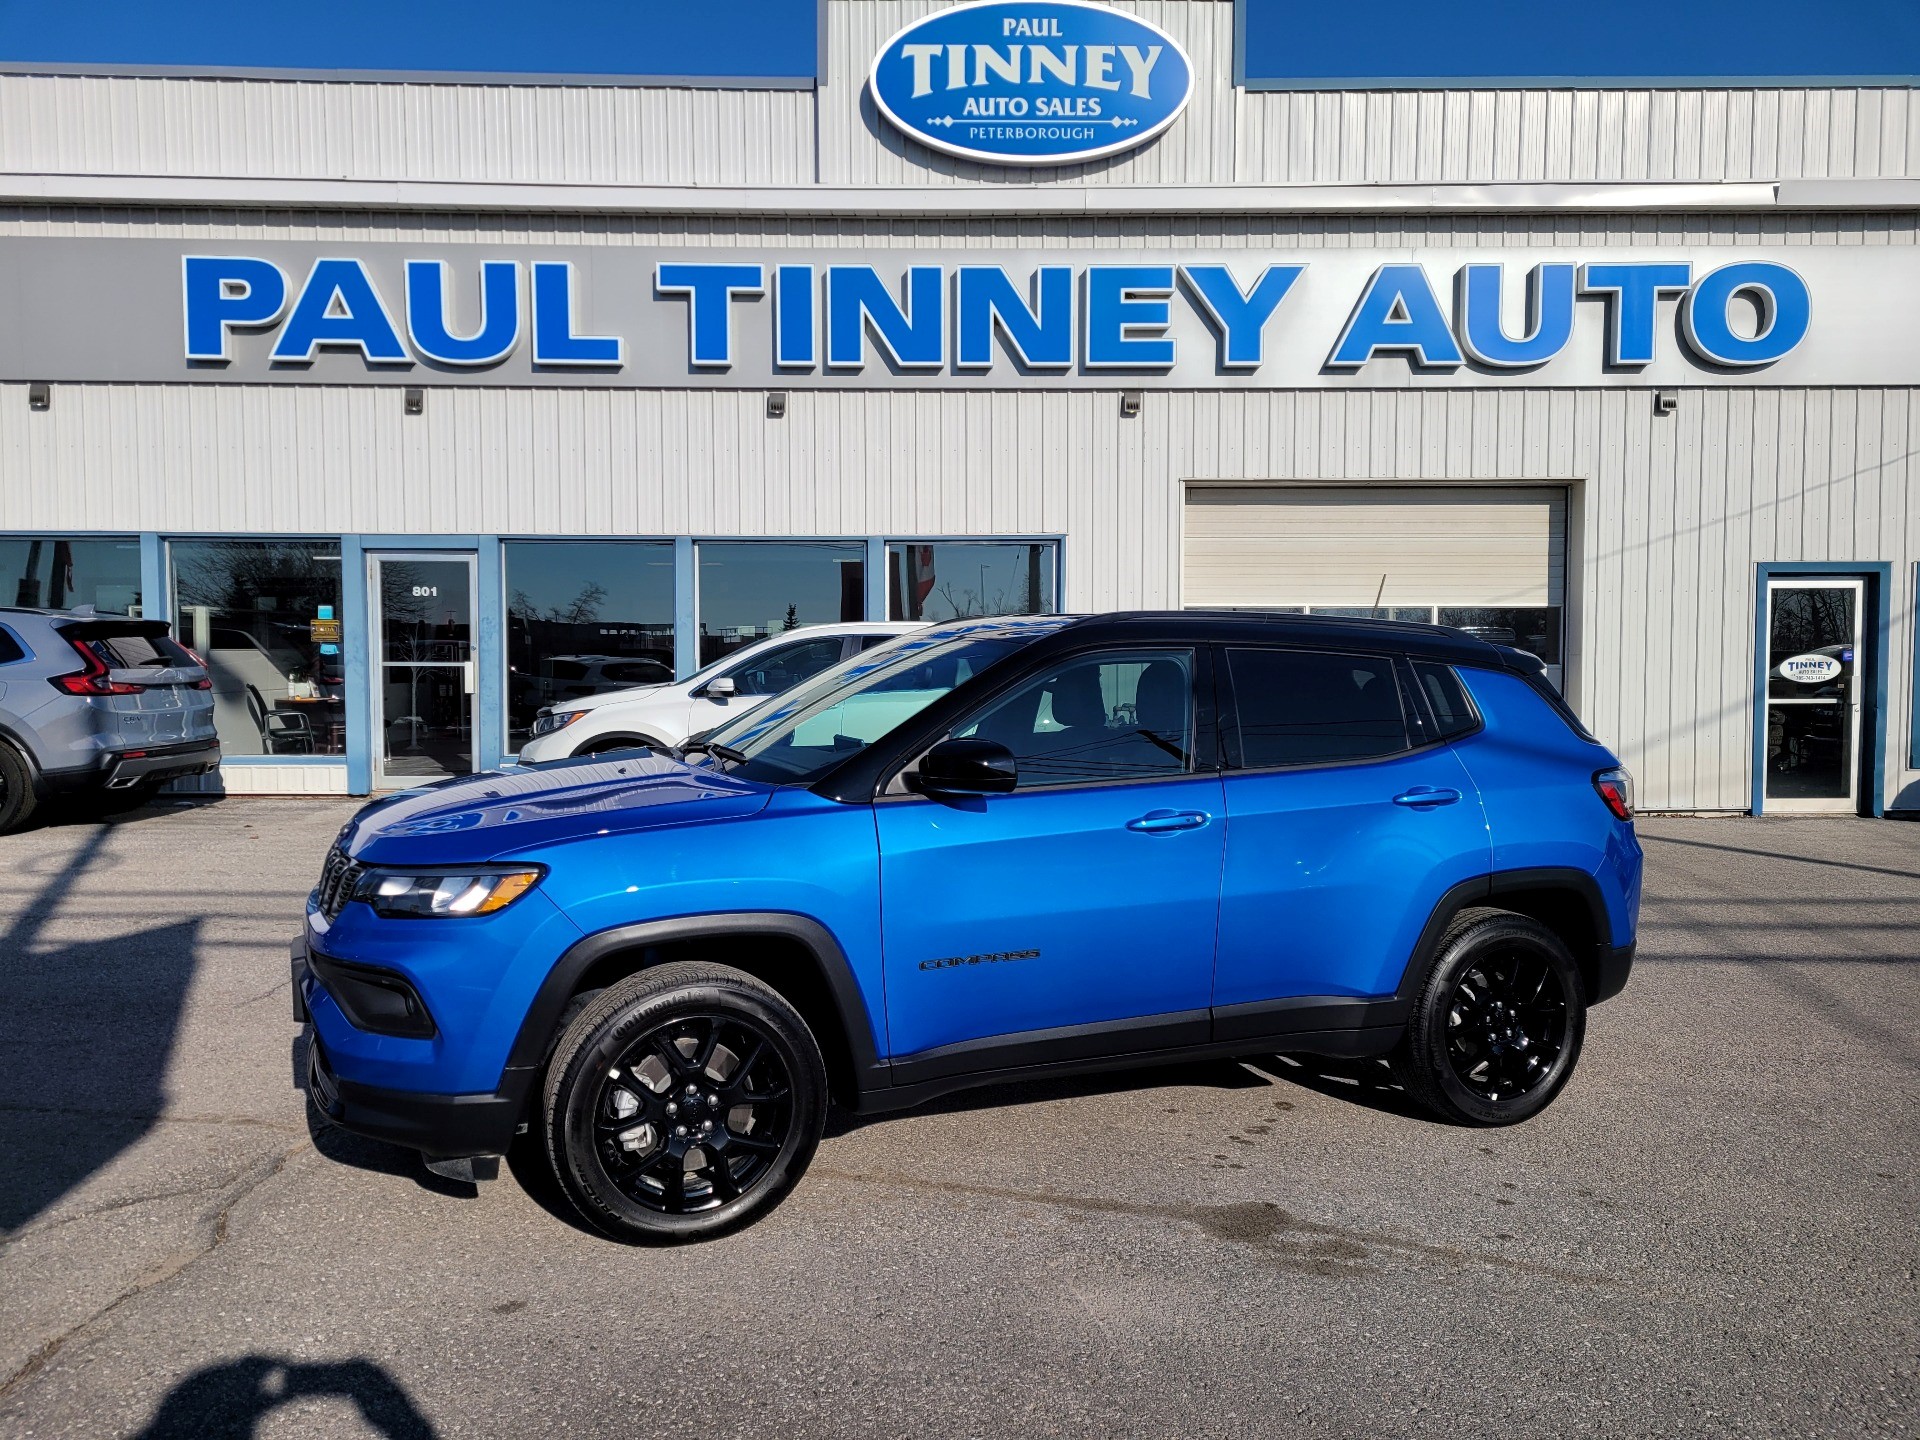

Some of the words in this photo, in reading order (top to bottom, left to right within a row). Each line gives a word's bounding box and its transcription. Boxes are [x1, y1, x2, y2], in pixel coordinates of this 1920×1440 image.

[1003, 18, 1063, 37] PAUL
[901, 44, 1163, 100] TINNEY
[962, 98, 1028, 117] AUTO
[1035, 99, 1102, 117] SALES
[970, 127, 1095, 140] PETERBOROUGH
[182, 255, 625, 366] PAUL
[655, 262, 1309, 369] TINNEY
[1326, 260, 1813, 367] AUTO
[412, 586, 437, 597] 801
[1788, 661, 1833, 671] TINNEY
[919, 949, 1040, 971] COMPASS
